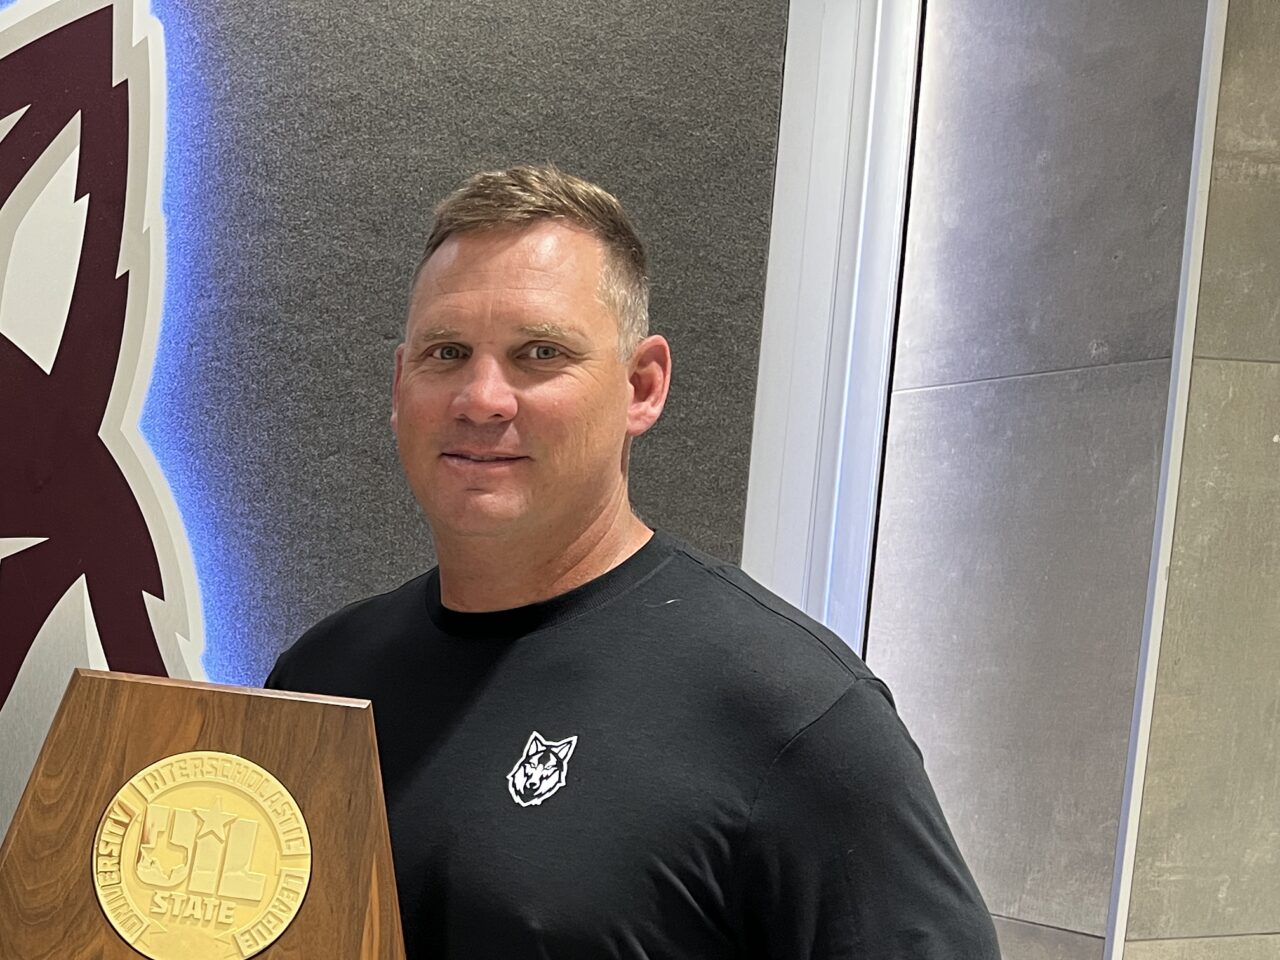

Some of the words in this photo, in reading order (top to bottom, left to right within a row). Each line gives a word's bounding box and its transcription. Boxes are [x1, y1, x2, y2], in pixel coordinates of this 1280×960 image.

[96, 799, 144, 937] UNIVERSITY
[138, 757, 306, 851] INTERSCHOLASTIC
[243, 870, 306, 949] LEAGUE
[150, 890, 237, 924] STATE
